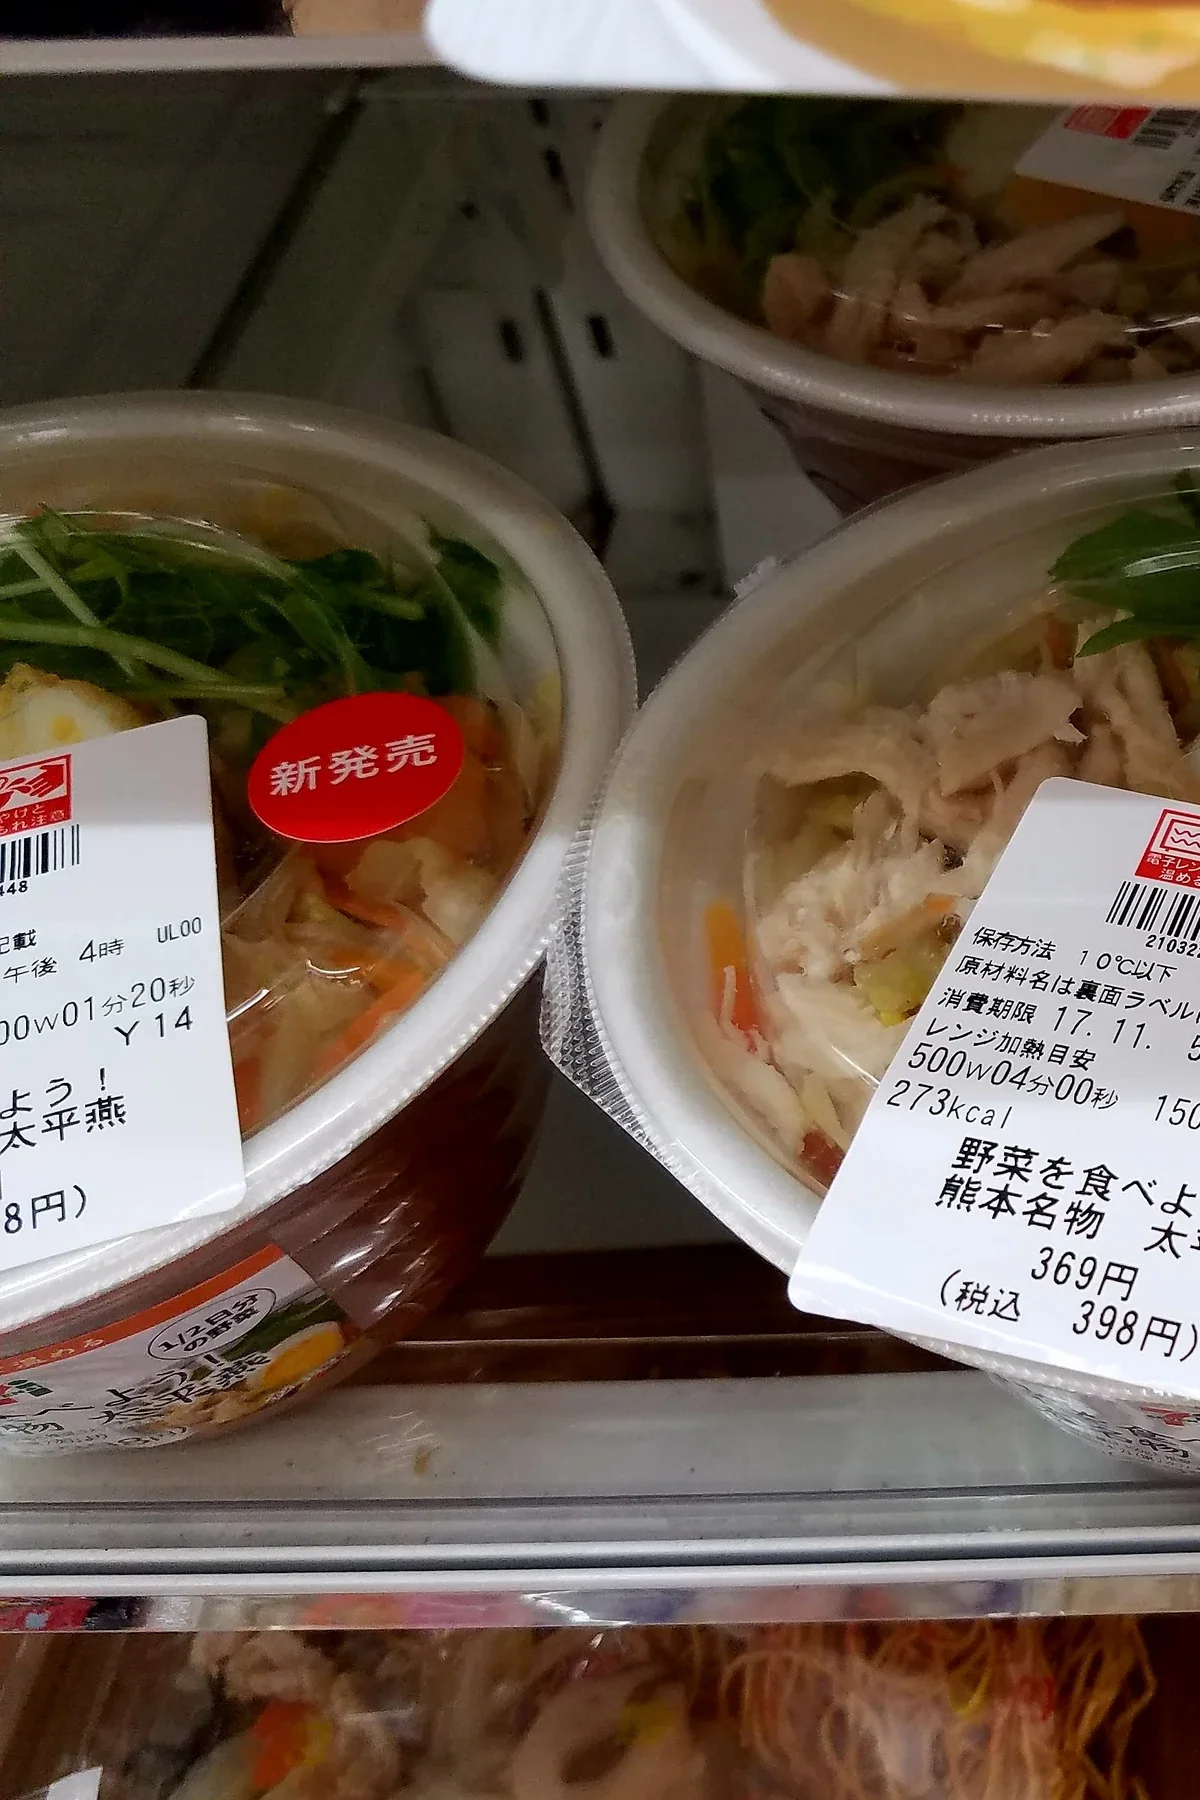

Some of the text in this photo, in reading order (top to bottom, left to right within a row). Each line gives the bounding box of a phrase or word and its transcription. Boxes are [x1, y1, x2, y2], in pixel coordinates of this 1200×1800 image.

[269, 733, 438, 798] 新発売
[156, 916, 203, 945] UL00
[972, 926, 1056, 961] 保存方法
[3, 938, 126, 984] 午後 4時
[937, 987, 1038, 1025] 消費期限
[926, 1017, 1098, 1072] レンジ加熱目安
[886, 1079, 1012, 1131] 273kcal
[934, 1174, 1106, 1240] 熊本名物
[1031, 1246, 1140, 1303] 369円
[1072, 1301, 1199, 1363] 398円)
